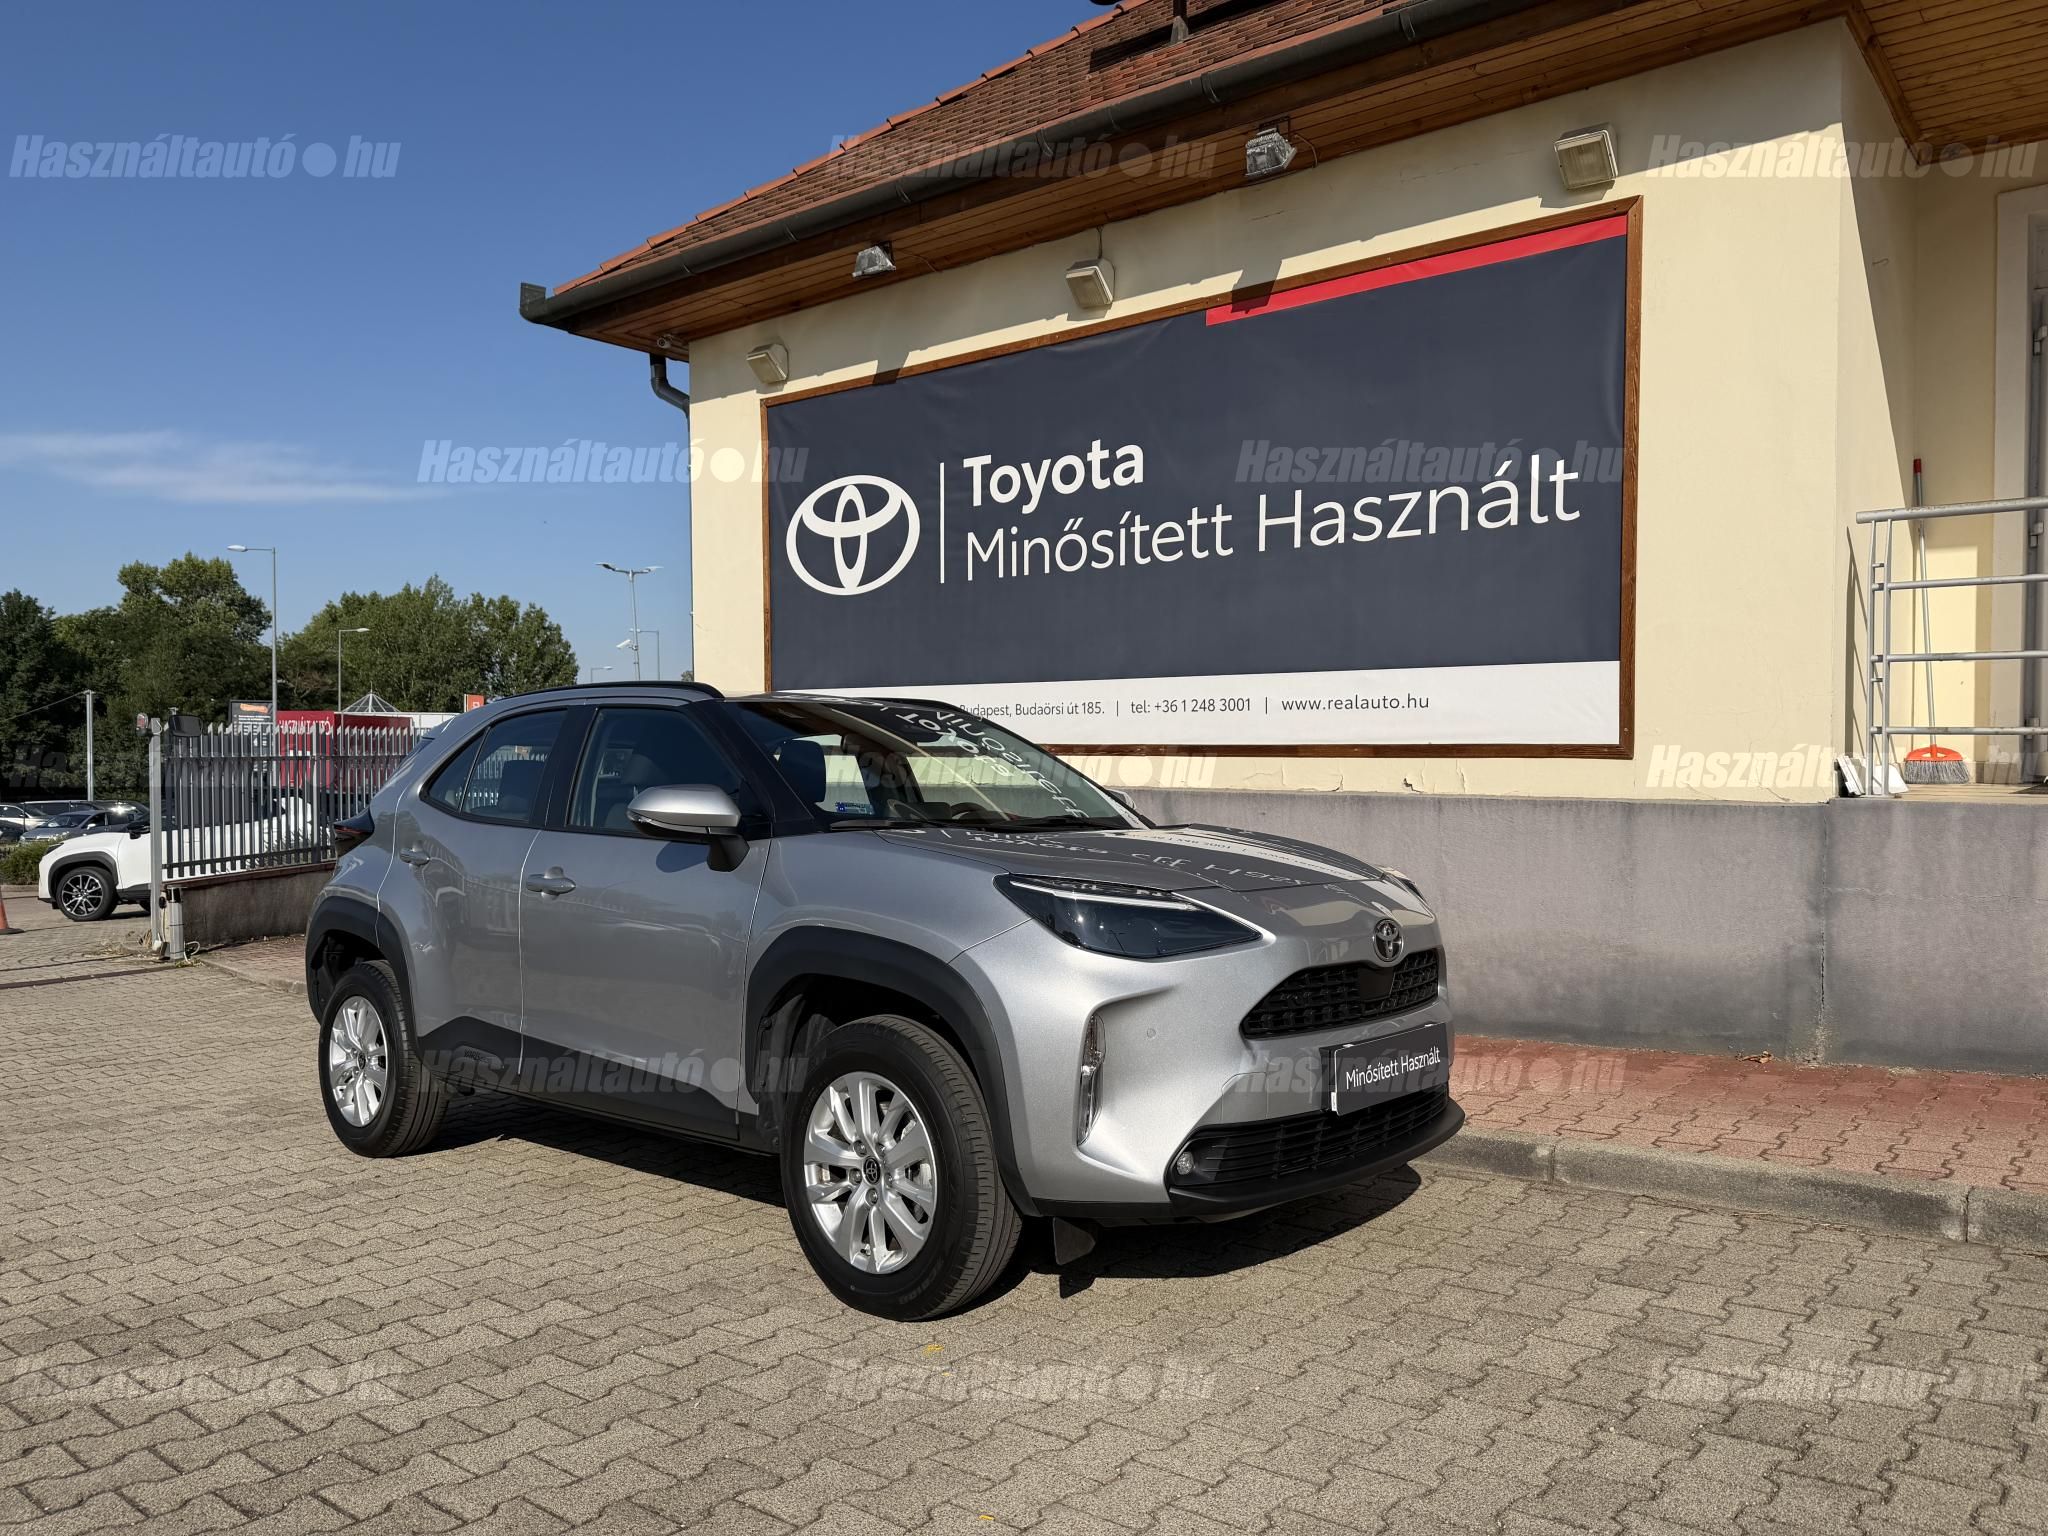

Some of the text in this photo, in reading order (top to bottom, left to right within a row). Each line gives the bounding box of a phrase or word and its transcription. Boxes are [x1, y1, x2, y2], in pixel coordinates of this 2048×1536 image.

[963, 439, 1144, 515] Toyota
[967, 454, 1581, 582] Minősített Használt
[1015, 703, 1064, 716] Budaörsi
[1067, 702, 1079, 715] út
[1082, 701, 1105, 715] 185.
[1131, 700, 1150, 713] tel:
[1154, 699, 1178, 713] +36
[1191, 698, 1215, 712] 248
[1219, 698, 1251, 711] 3001
[1281, 692, 1430, 711] www.realauto.hu
[1346, 1045, 1441, 1090] Minősített Használt
